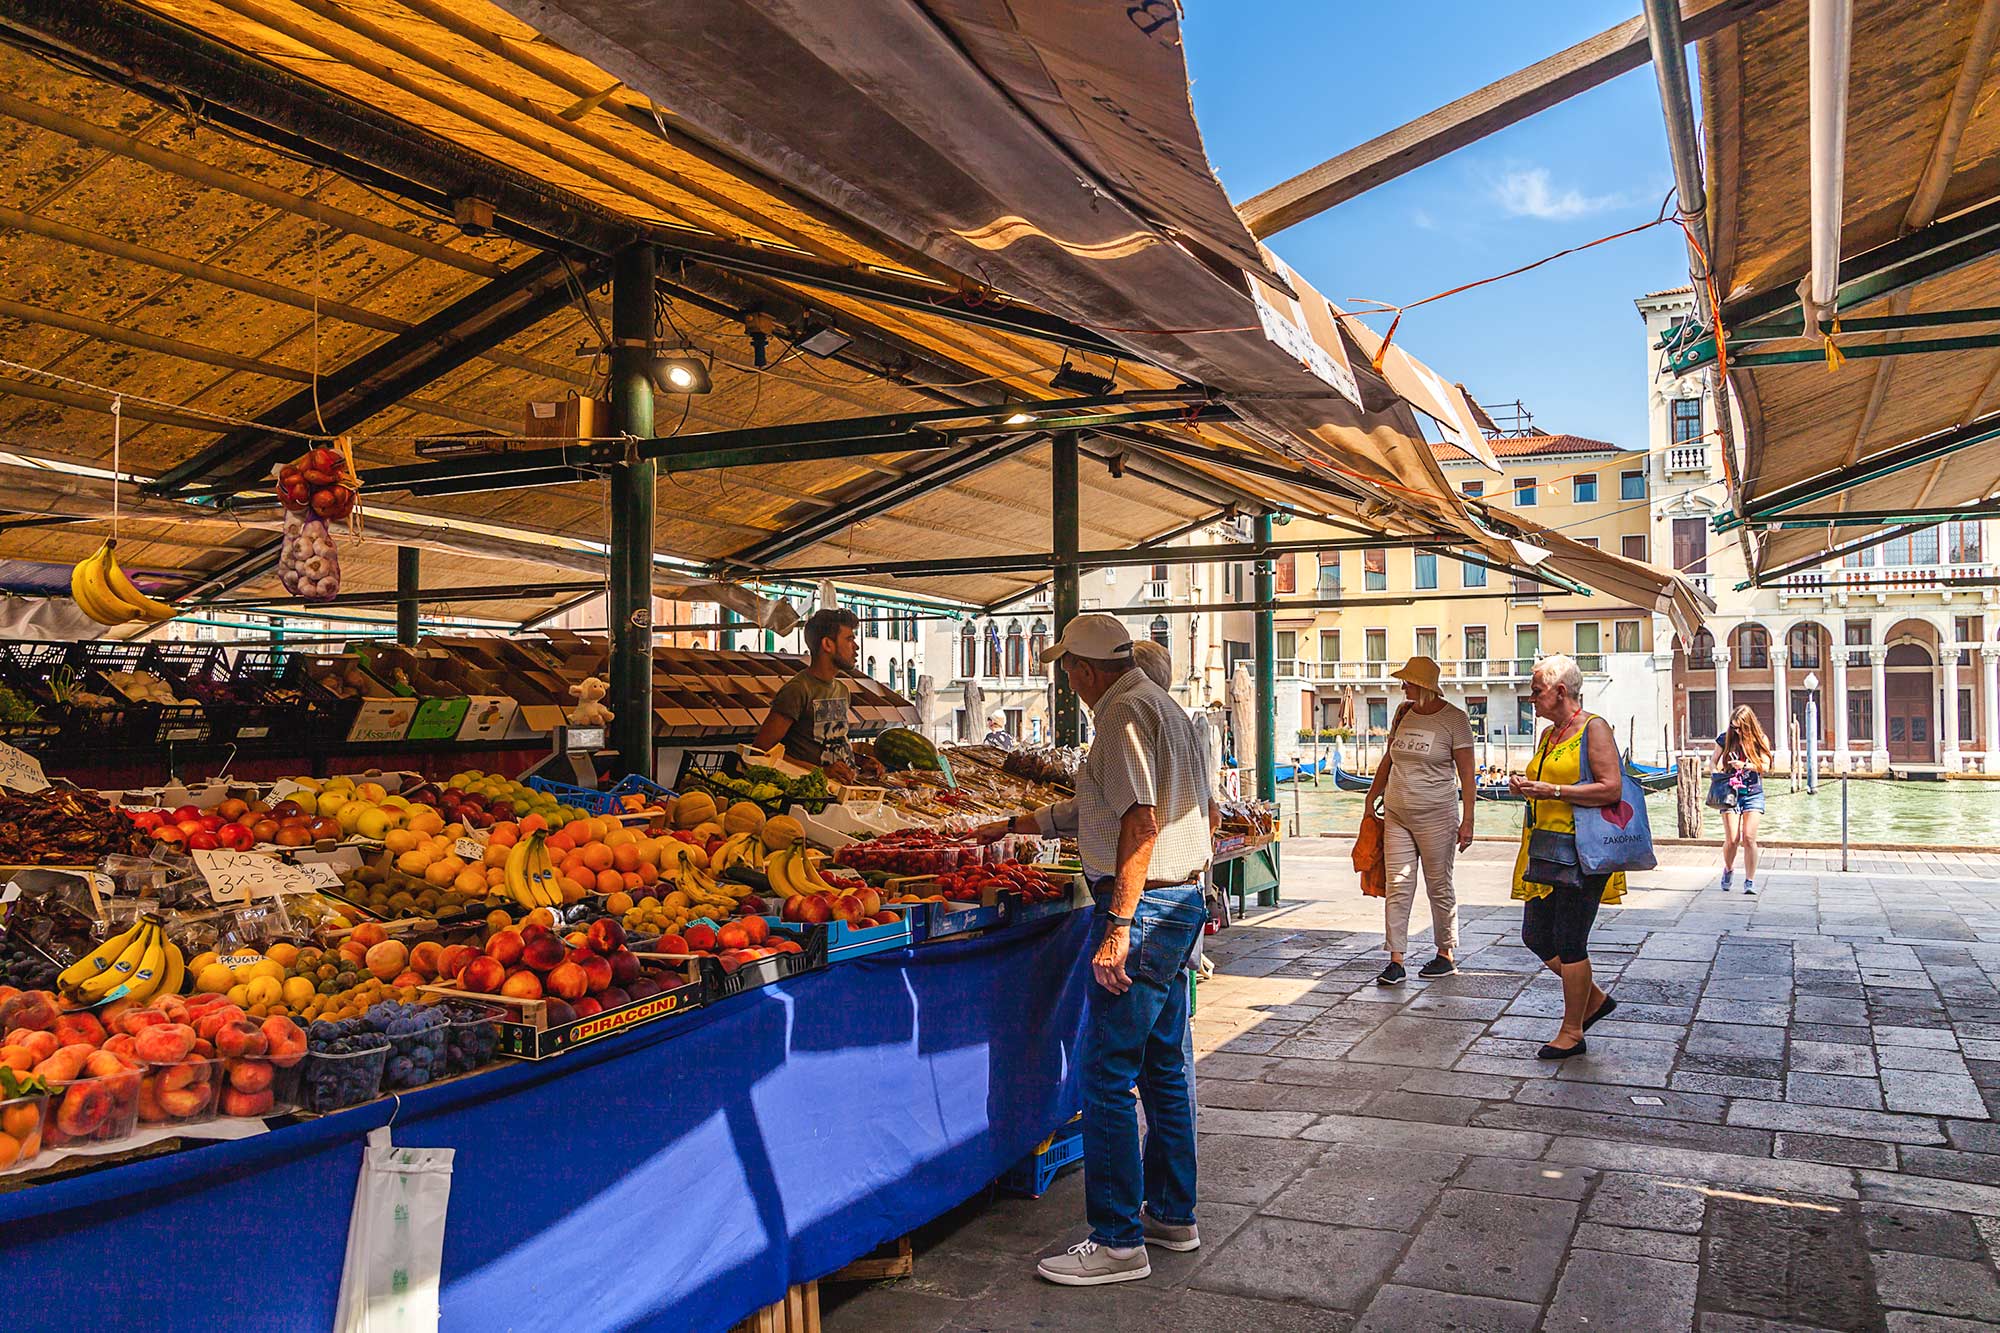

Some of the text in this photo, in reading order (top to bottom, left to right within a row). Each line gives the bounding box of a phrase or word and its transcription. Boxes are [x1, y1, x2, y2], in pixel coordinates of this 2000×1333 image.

[9, 758, 40, 777] SECCHI
[1602, 834, 1643, 845] ZAKOPANE
[580, 997, 677, 1037] PIRACCINI
